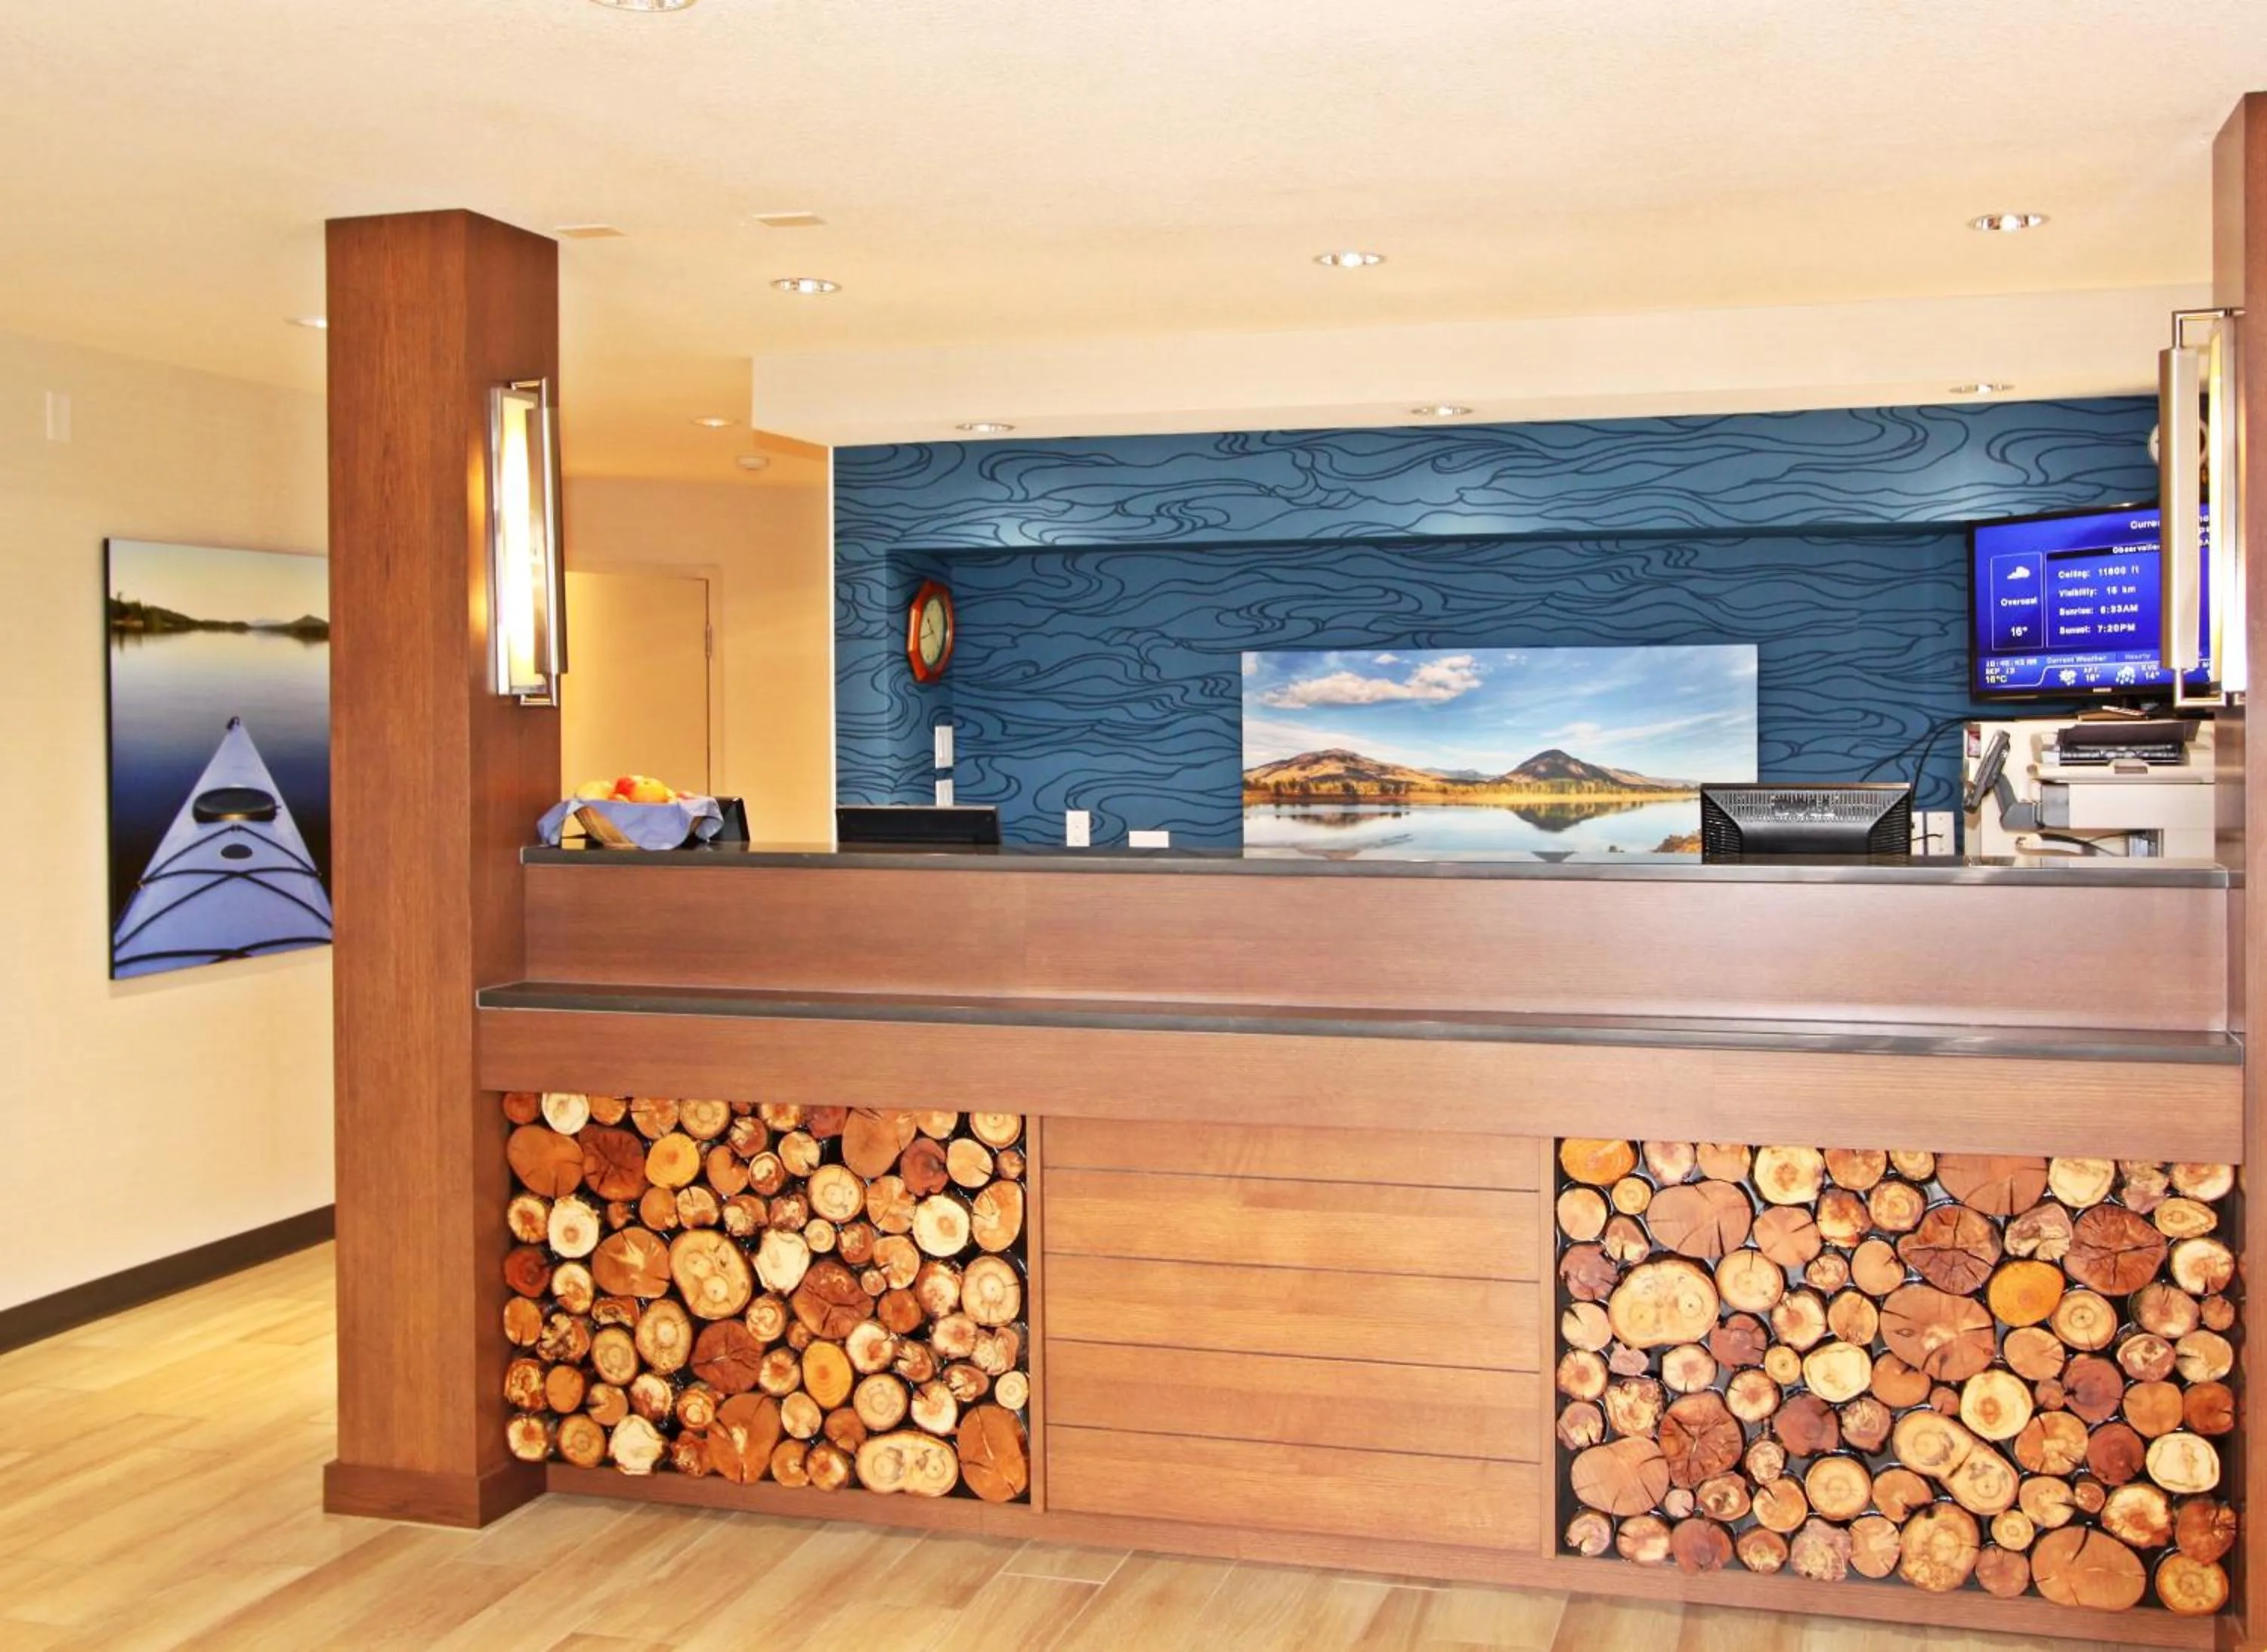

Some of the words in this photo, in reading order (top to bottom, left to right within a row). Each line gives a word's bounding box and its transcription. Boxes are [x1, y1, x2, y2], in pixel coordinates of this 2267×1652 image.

[2058, 570, 2090, 580] Ceiling:
[2058, 587, 2097, 598] Visibility:
[2059, 607, 2093, 617] Sunrise:
[2059, 625, 2091, 636] Sunset:
